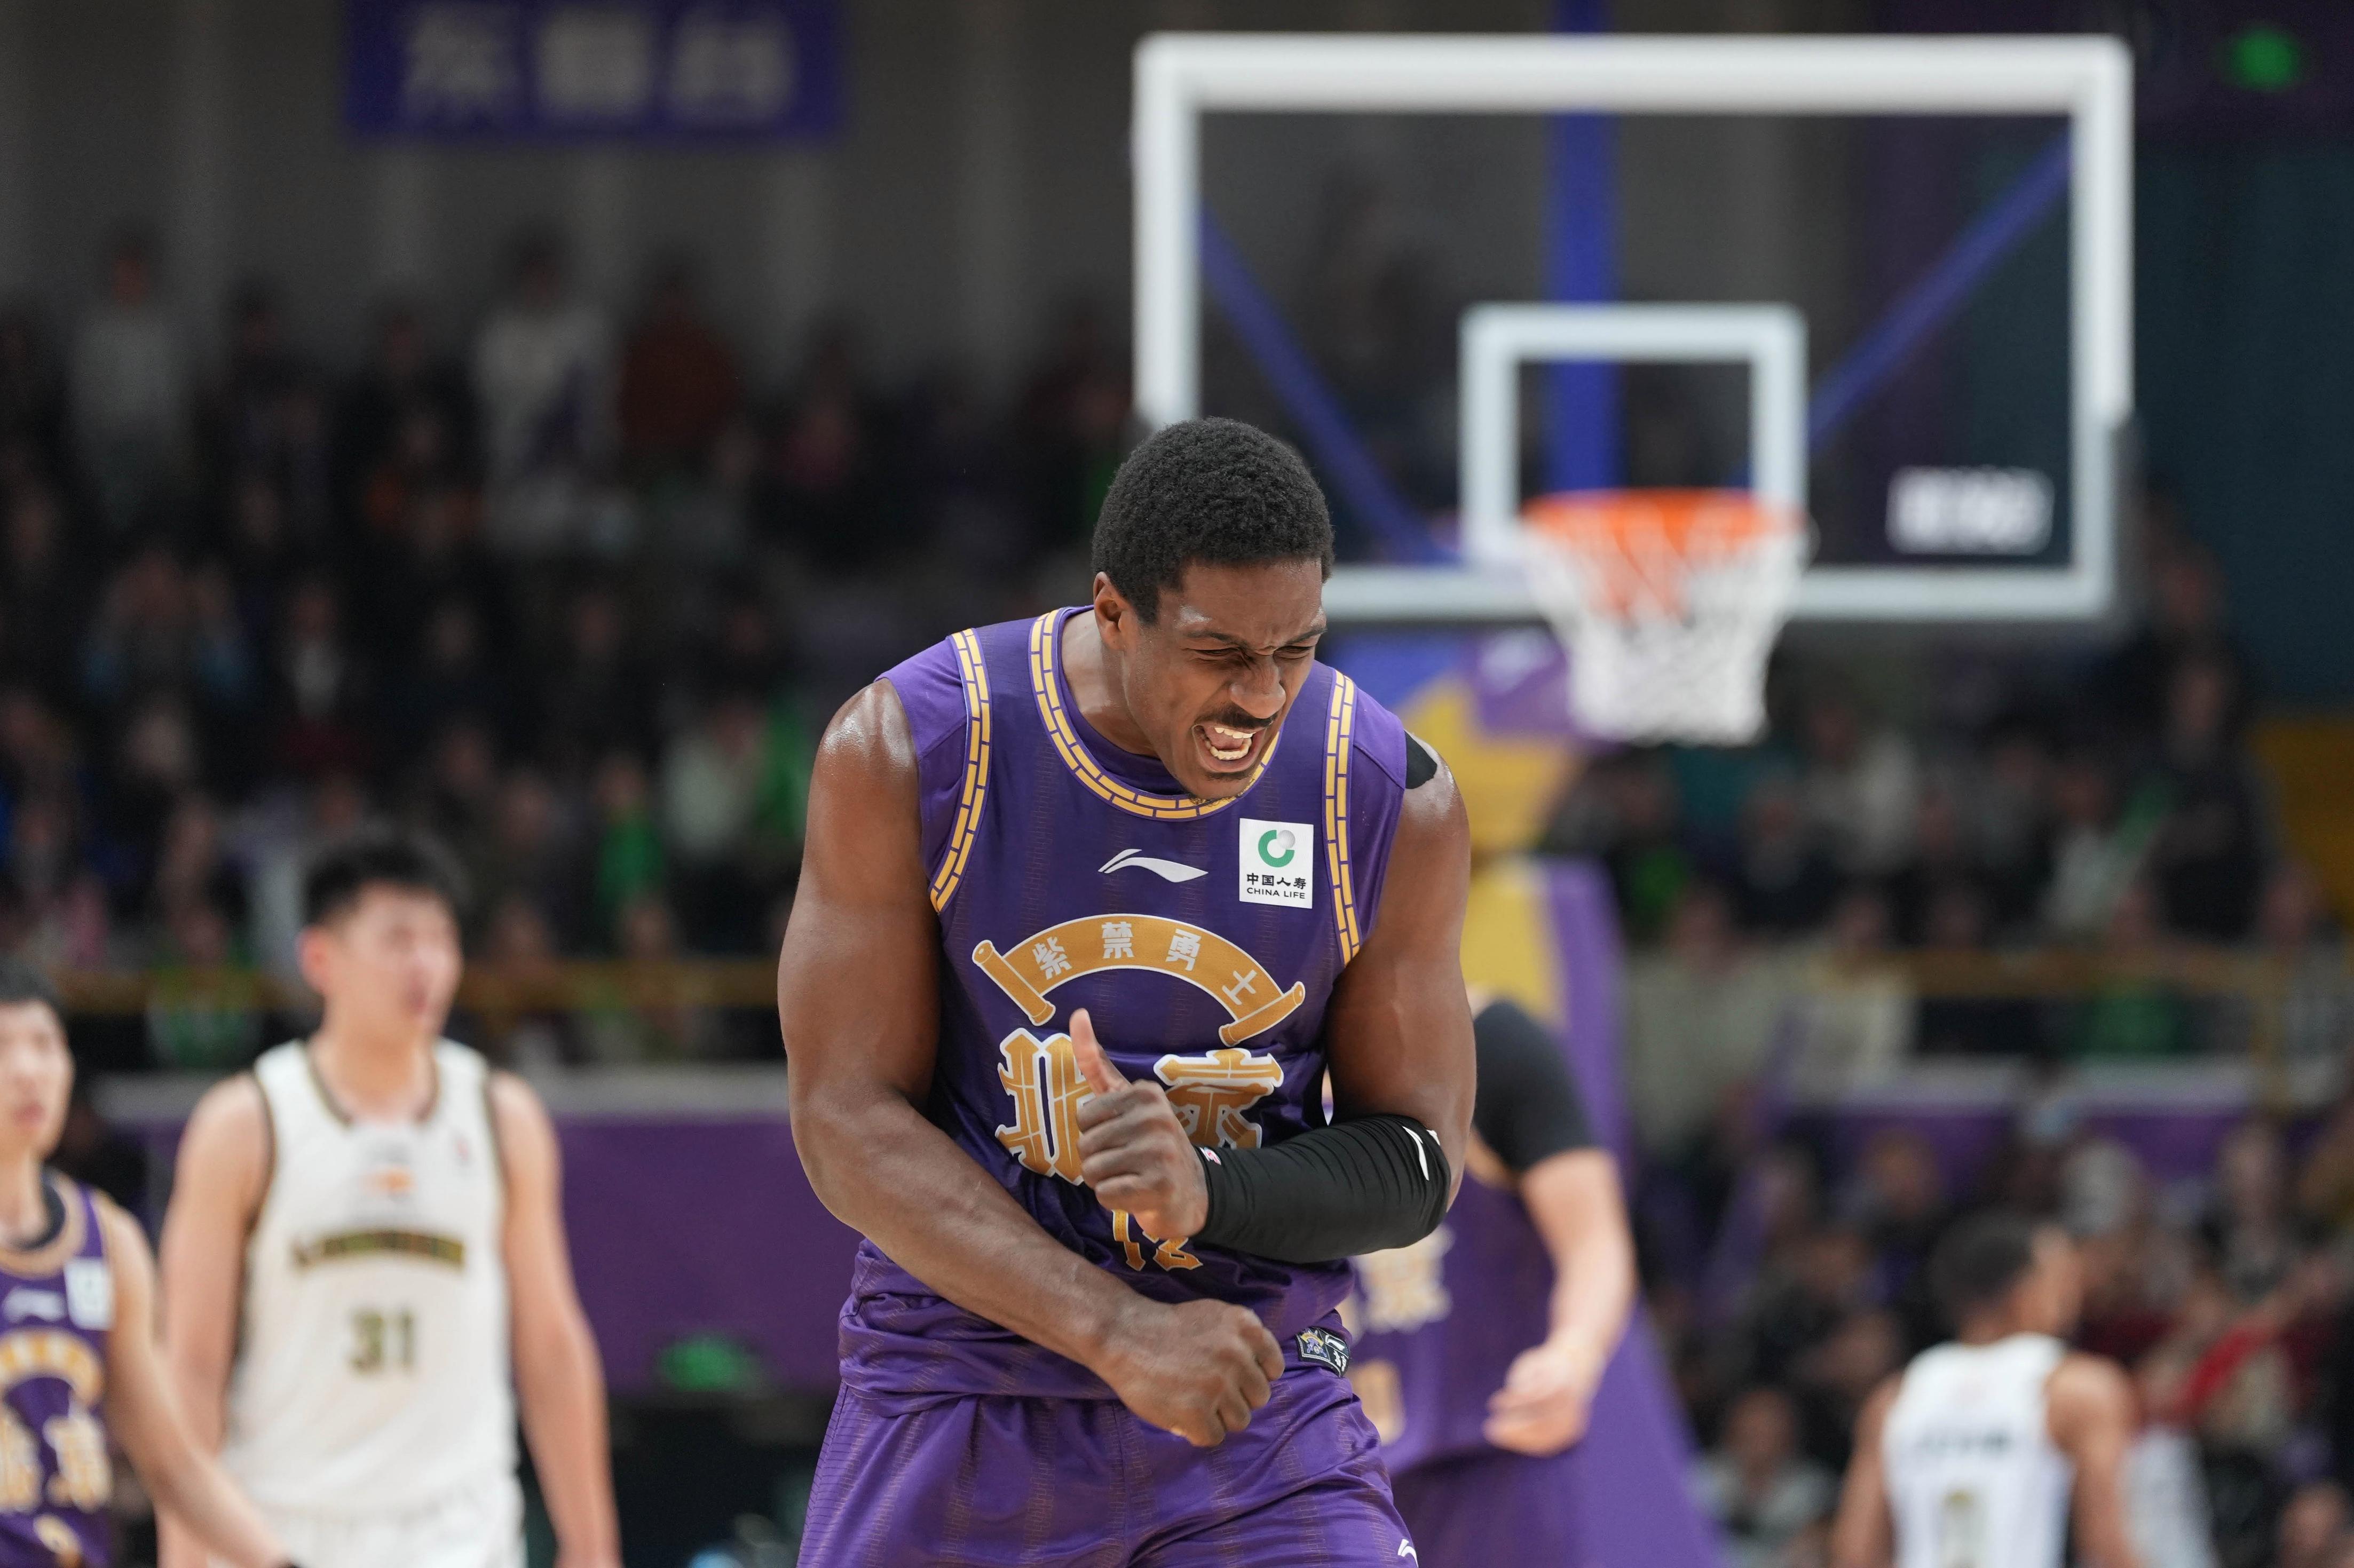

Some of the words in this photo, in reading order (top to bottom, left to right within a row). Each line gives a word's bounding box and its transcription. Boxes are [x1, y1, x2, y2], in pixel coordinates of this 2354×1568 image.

[1246, 873, 1306, 890] 中国人寿
[1246, 887, 1280, 897] CHINA
[1284, 891, 1306, 899] LIFE
[1032, 921, 1258, 1005] 紫禁勇士
[351, 1305, 414, 1374] 31
